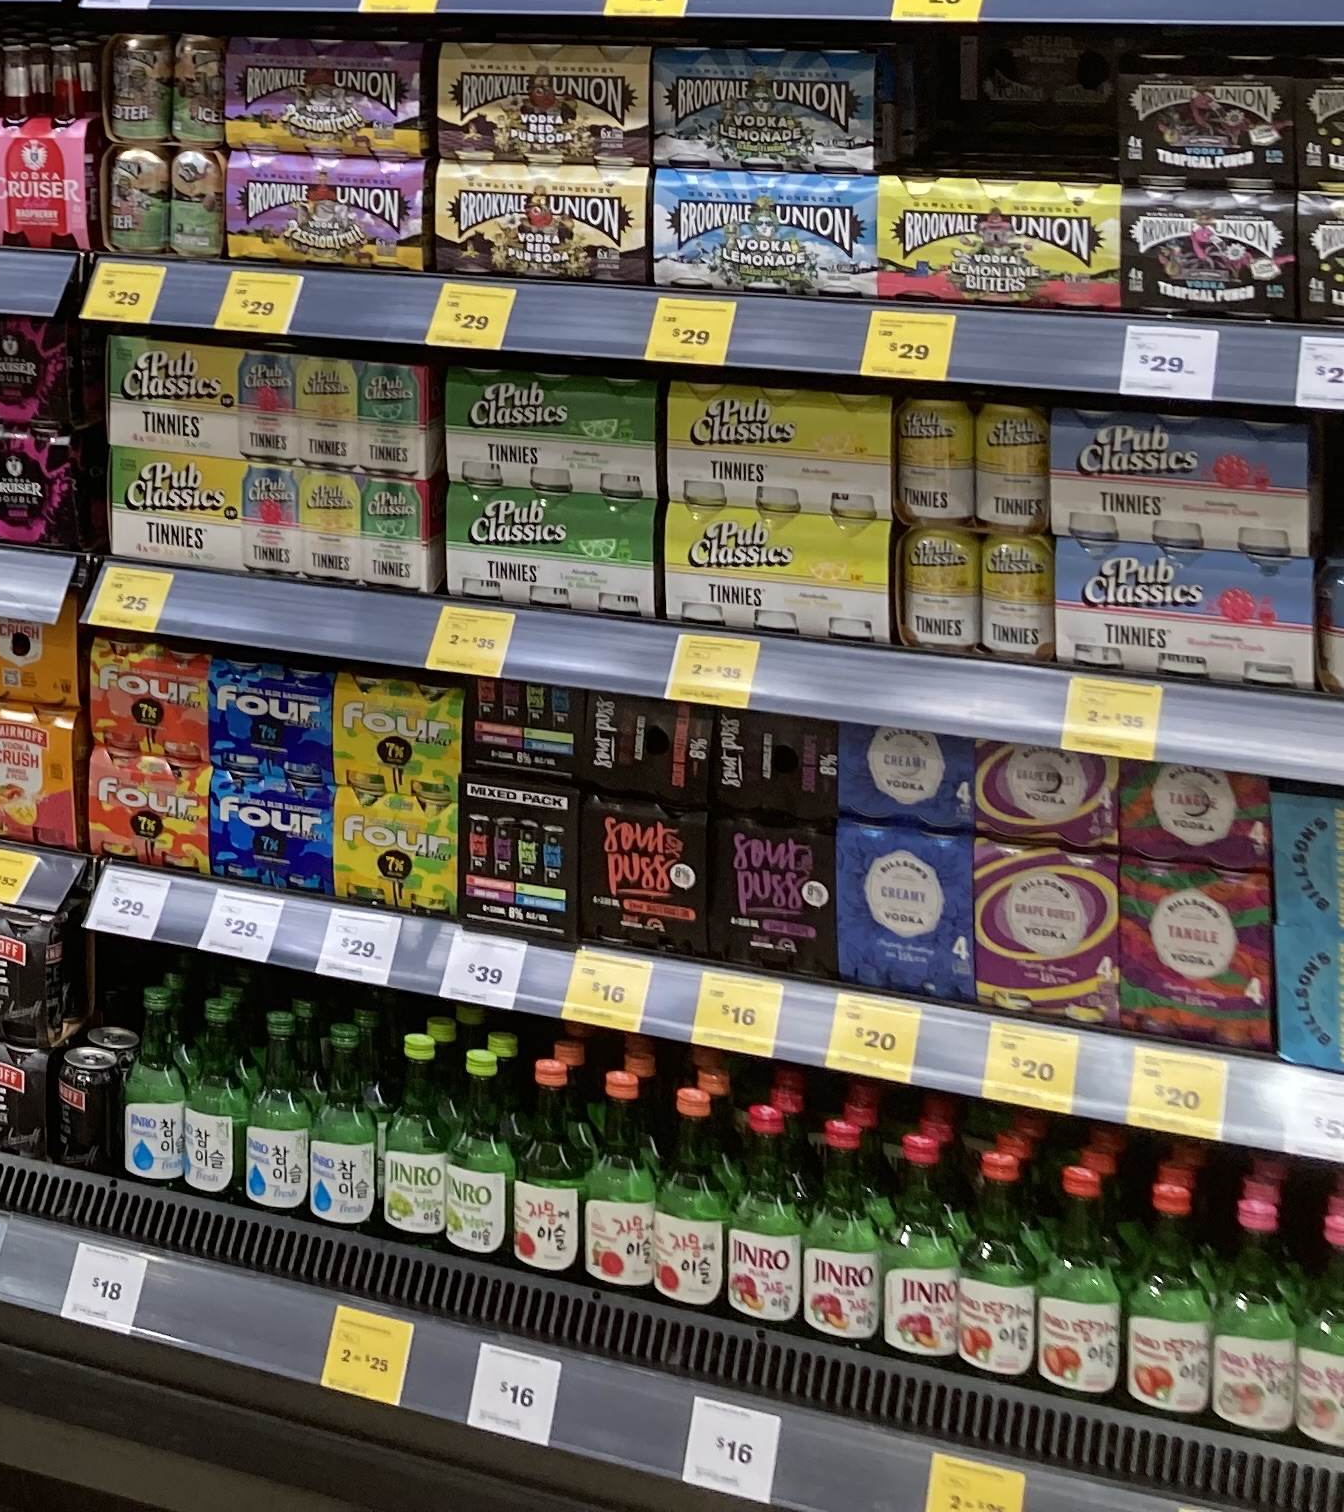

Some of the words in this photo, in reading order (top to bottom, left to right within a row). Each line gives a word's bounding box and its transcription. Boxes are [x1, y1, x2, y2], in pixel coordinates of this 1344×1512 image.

[462, 75, 530, 113] BROOKVALE
[552, 78, 622, 115] UNION
[521, 113, 563, 126] VODKA
[510, 131, 537, 144] PUB
[538, 131, 572, 144] SODA
[10, 171, 60, 181] VODKA
[15, 209, 59, 220] RASPBERRY
[247, 185, 308, 221] BROOKVALE
[336, 186, 400, 229] UNION
[679, 199, 752, 240] BROOKVALE
[776, 204, 854, 251] UNION
[736, 239, 792, 253] VODKA
[904, 213, 977, 253] BROOKVALE
[1012, 214, 1090, 261] UNION
[721, 250, 805, 266] LEMONADE
[951, 263, 999, 278] LEMON
[1002, 264, 1039, 278] LIME
[965, 276, 1025, 291] BITTERS
[1157, 284, 1212, 300] TROPICAL
[1213, 286, 1253, 302] PUNCH
[241, 300, 275, 316] $29
[889, 342, 929, 360] $29
[136, 350, 198, 378] Pub
[1140, 355, 1183, 373] $29
[123, 371, 222, 399] Classics
[484, 382, 545, 408] Pub
[142, 410, 203, 439] TINNIES
[470, 401, 568, 427] Classics
[488, 443, 541, 465] TINNIES
[1103, 557, 1175, 585] Pub
[116, 595, 148, 612] $25
[1084, 578, 1203, 608] Classics
[915, 614, 964, 637] TINNIES
[1105, 623, 1170, 648] TINNIES
[2, 740, 30, 752] VODKA
[470, 786, 519, 802] MIXED
[523, 793, 564, 807] PACK
[385, 855, 405, 873] 7%
[881, 885, 927, 903] CREAMY
[1168, 925, 1218, 944] TANGLE
[468, 964, 502, 984] $39
[1011, 1057, 1054, 1082] $20
[388, 1159, 442, 1187] JINRO
[732, 1237, 790, 1271] JINRO
[813, 1258, 874, 1288] JINRO
[92, 1277, 121, 1301] $18
[365, 1355, 388, 1373] $25
[500, 1380, 534, 1408] $16
